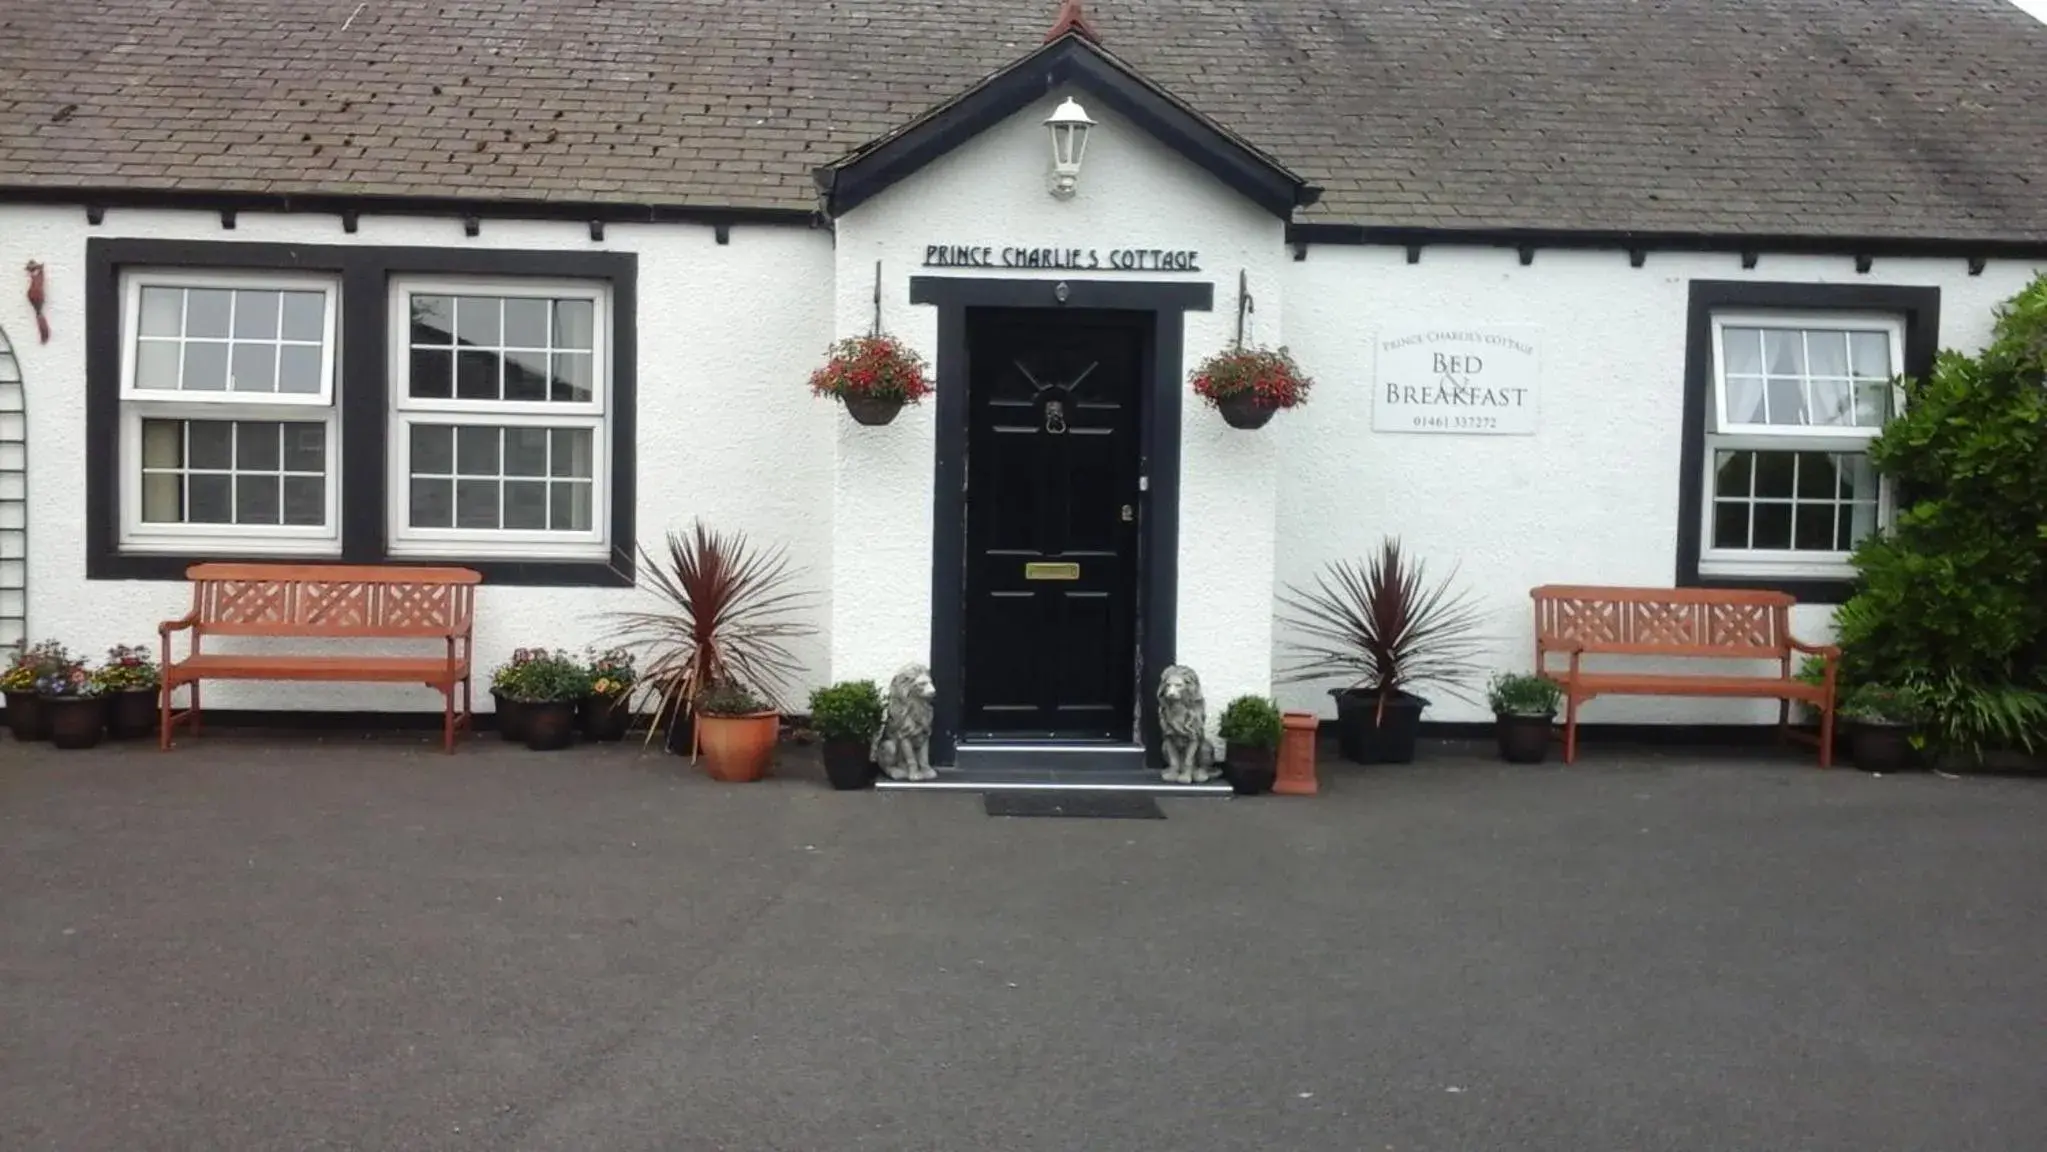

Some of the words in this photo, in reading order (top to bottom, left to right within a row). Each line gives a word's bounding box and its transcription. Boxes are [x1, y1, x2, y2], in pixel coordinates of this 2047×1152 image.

[926, 244, 993, 266] PRINCE
[1110, 249, 1200, 271] COTTAGE
[1382, 335, 1423, 352] PRINCE
[1484, 334, 1533, 355] COTTAGE
[1413, 416, 1449, 428] 01461
